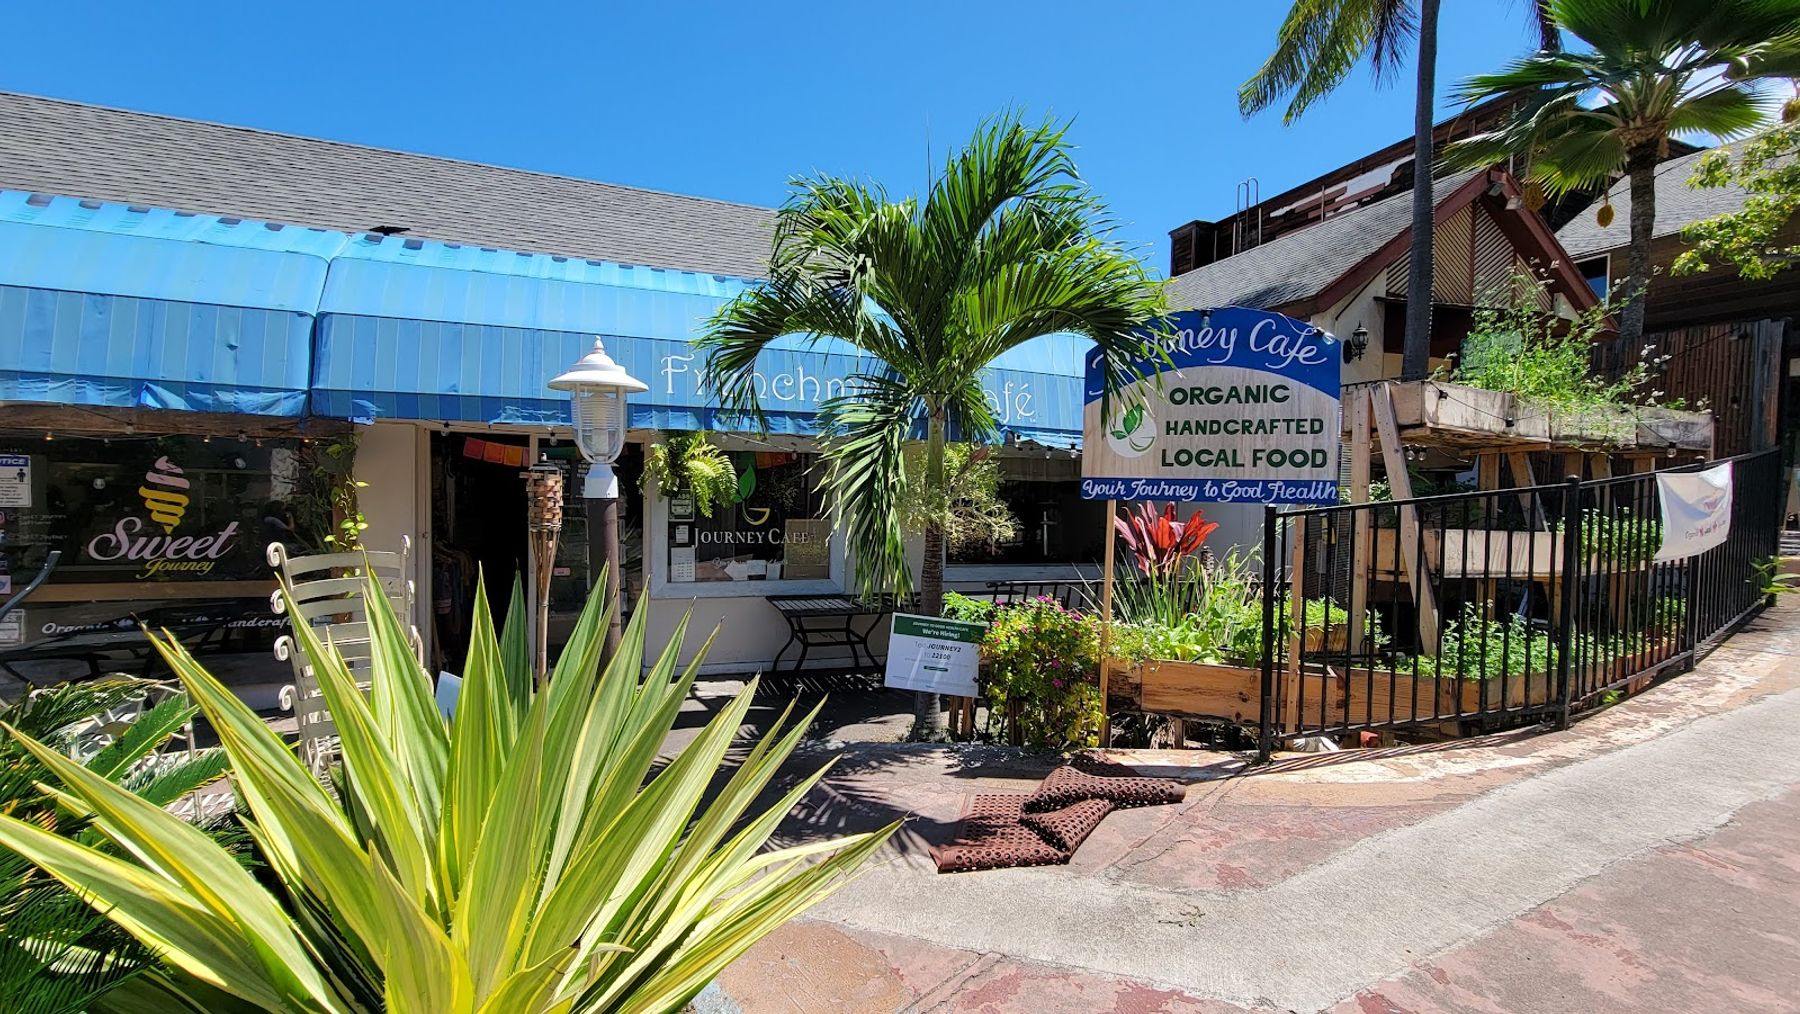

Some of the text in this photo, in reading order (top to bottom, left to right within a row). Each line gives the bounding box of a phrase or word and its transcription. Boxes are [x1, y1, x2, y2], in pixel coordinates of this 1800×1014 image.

[1249, 318, 1328, 369] Cafe
[978, 382, 1036, 425] afé
[1169, 384, 1290, 405] ORGANIC
[1165, 418, 1324, 436] HANDCRAFTED
[0, 458, 26, 466] TICE
[1161, 449, 1328, 468] LOCAL FOOD
[1123, 480, 1198, 501] Journey
[1203, 480, 1218, 497] to
[1217, 481, 1264, 502] Good
[1262, 481, 1338, 503] Health
[88, 516, 239, 560] Sweet
[136, 557, 215, 579] Journey
